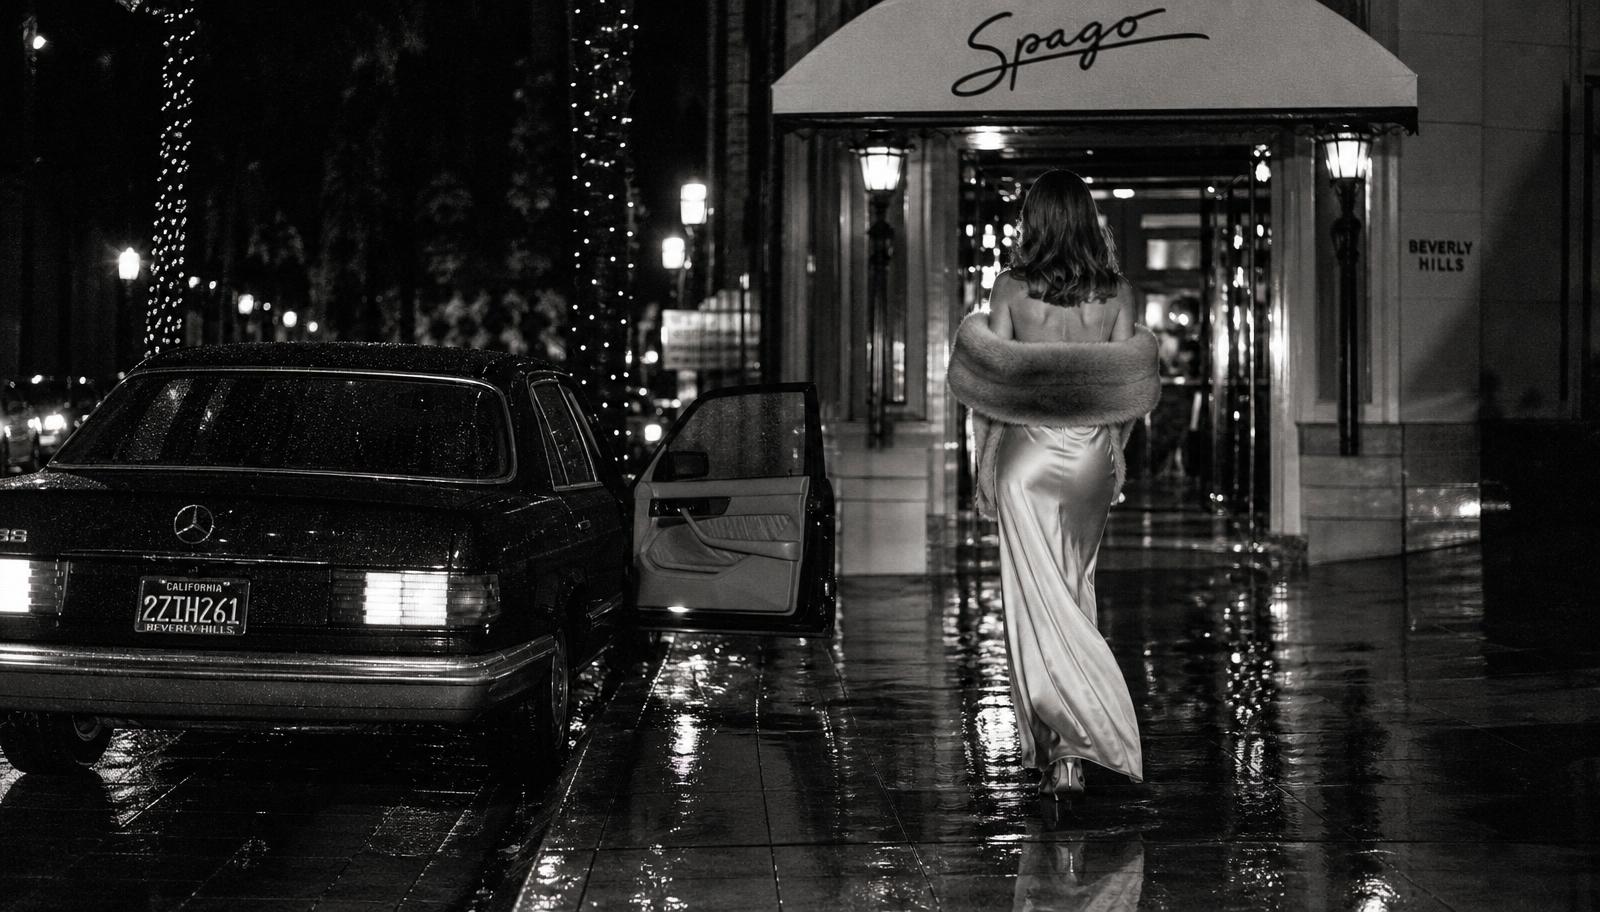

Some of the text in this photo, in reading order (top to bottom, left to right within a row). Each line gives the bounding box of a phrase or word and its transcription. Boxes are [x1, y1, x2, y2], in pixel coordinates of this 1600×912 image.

[951, 8, 1210, 97] Spago
[1409, 240, 1473, 255] BEVERLY
[1419, 257, 1464, 272] HILLS
[166, 582, 222, 592] CALIFORNIA
[142, 595, 240, 625] 2ZIH261
[146, 623, 197, 633] BEVERLY
